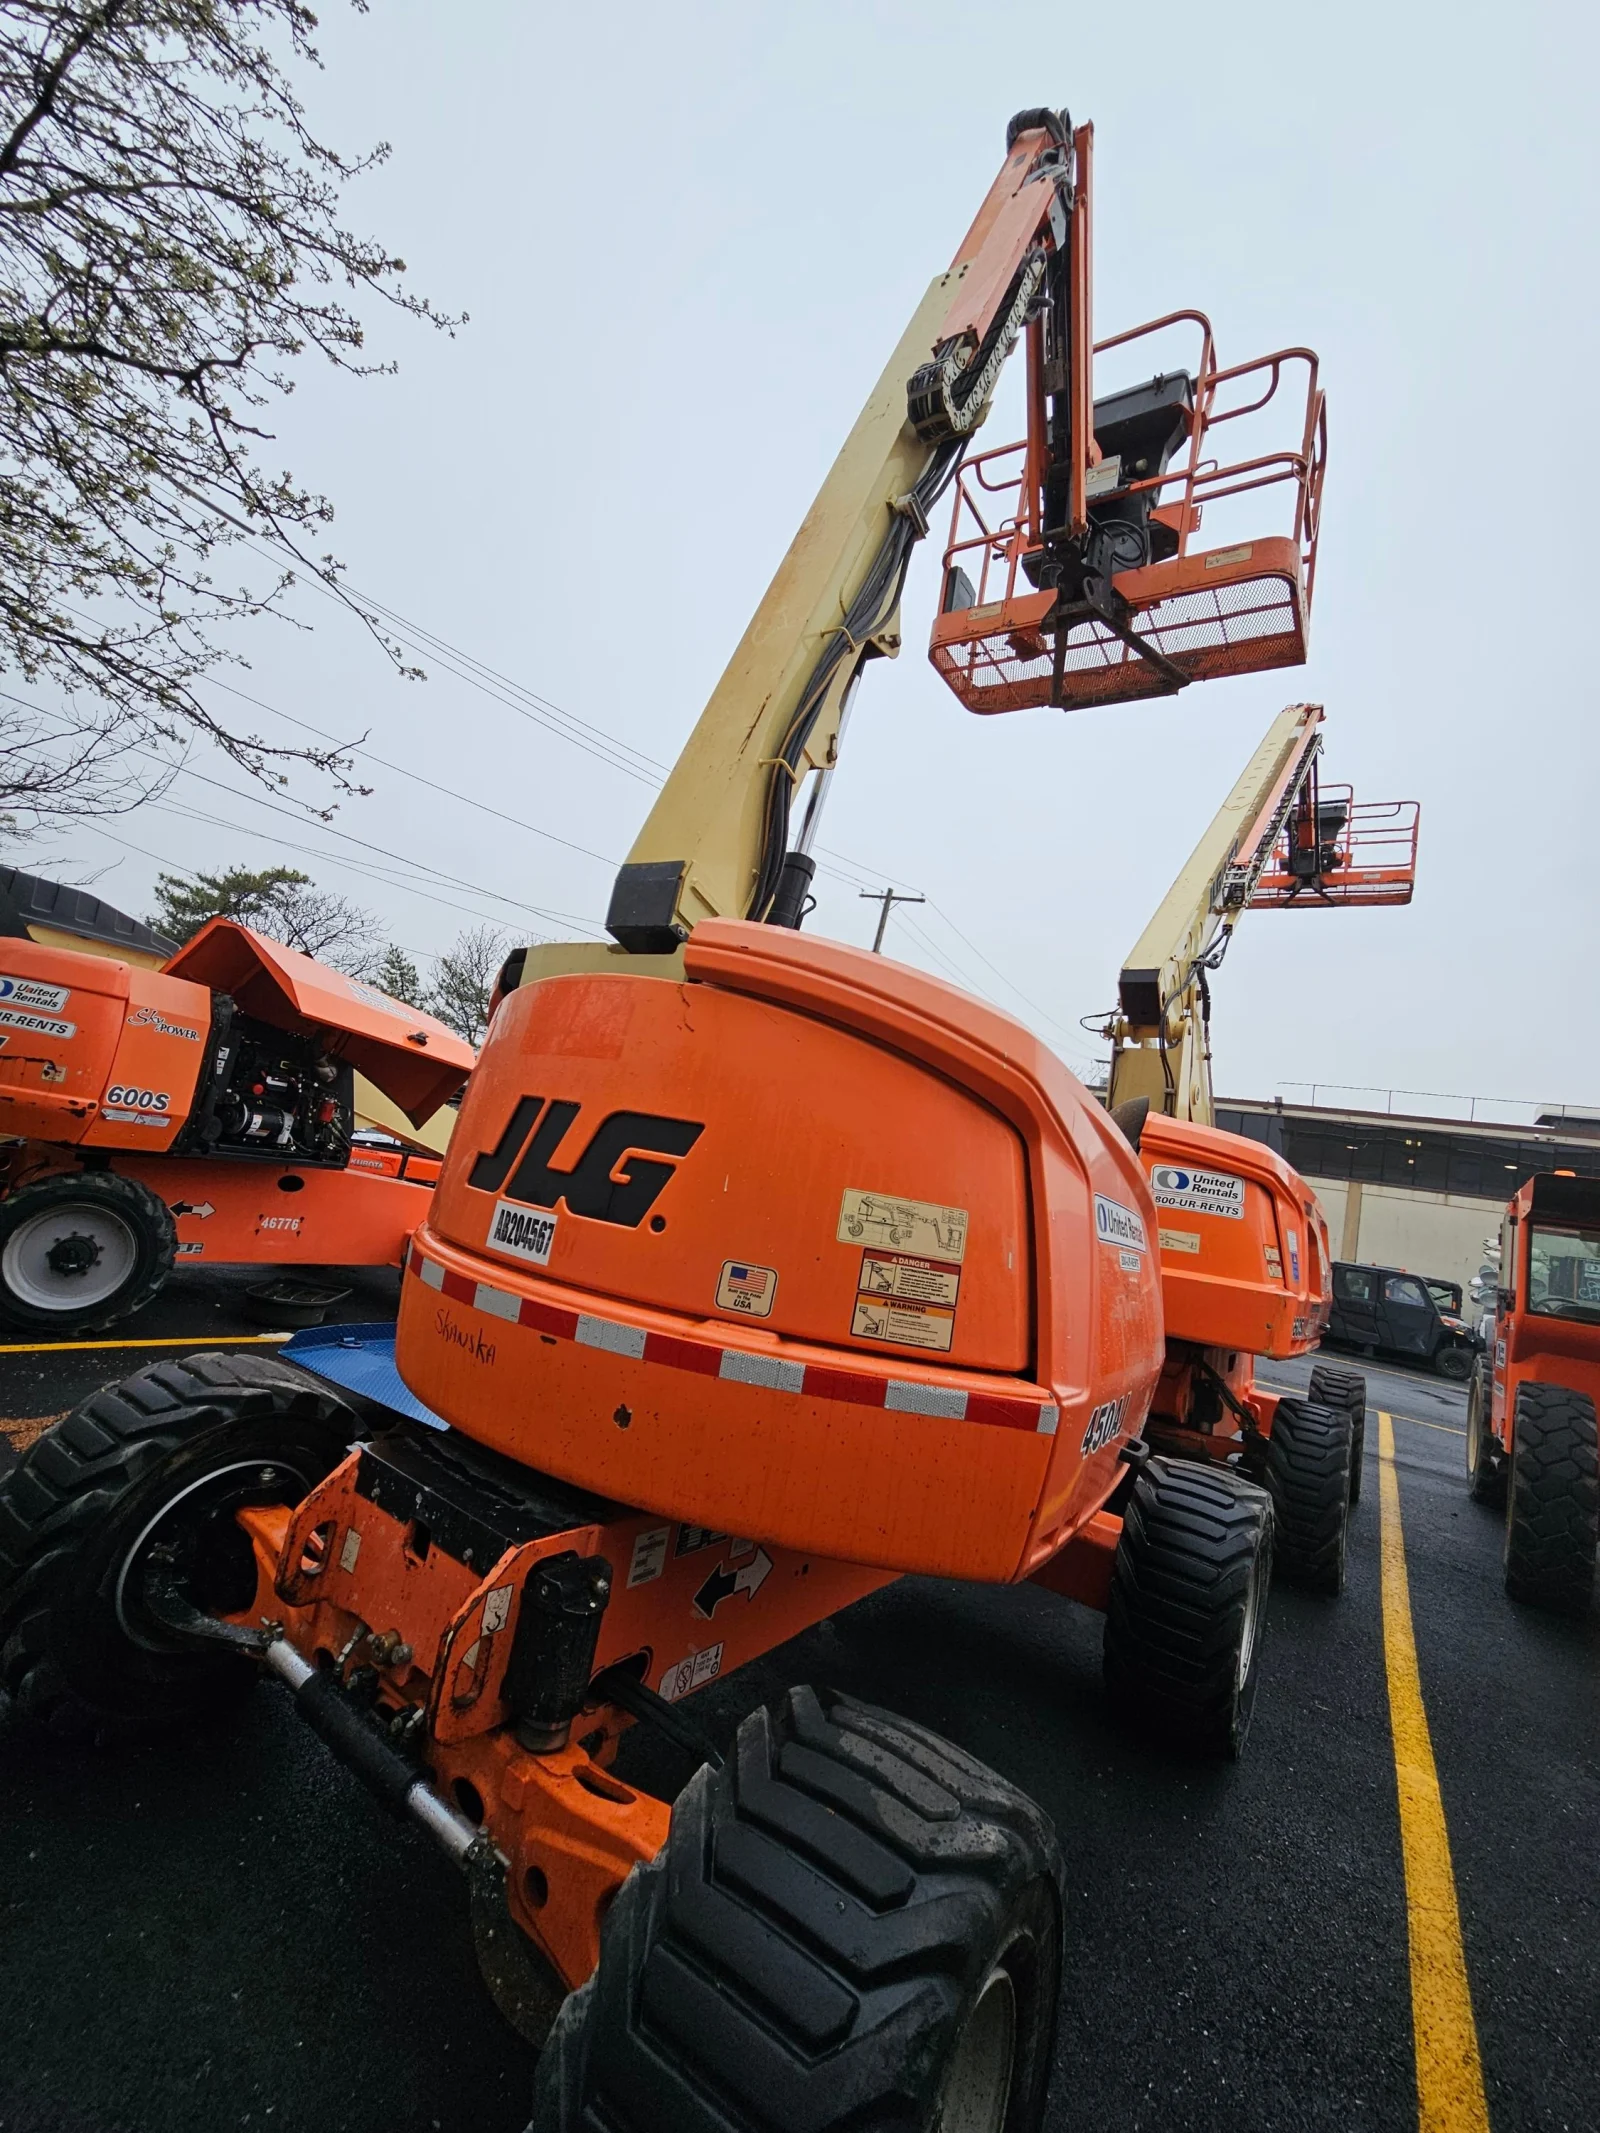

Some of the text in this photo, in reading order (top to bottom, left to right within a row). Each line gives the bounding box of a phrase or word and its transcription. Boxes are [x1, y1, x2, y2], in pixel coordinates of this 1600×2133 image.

[17, 983, 60, 999] United
[12, 992, 59, 1009] Rentals
[127, 1008, 198, 1040] Sky POWER
[107, 1086, 170, 1111] 600S
[350, 1157, 384, 1170] KUBOTA
[467, 1094, 705, 1229] JLG
[1192, 1174, 1236, 1190] United
[1191, 1184, 1239, 1200] Rentals
[261, 1216, 299, 1231] 46776
[1108, 1208, 1128, 1239] United
[493, 1209, 556, 1256] AB204567
[898, 1257, 931, 1270] DANGER
[733, 1299, 752, 1310] USA
[890, 1301, 926, 1313] WARNING
